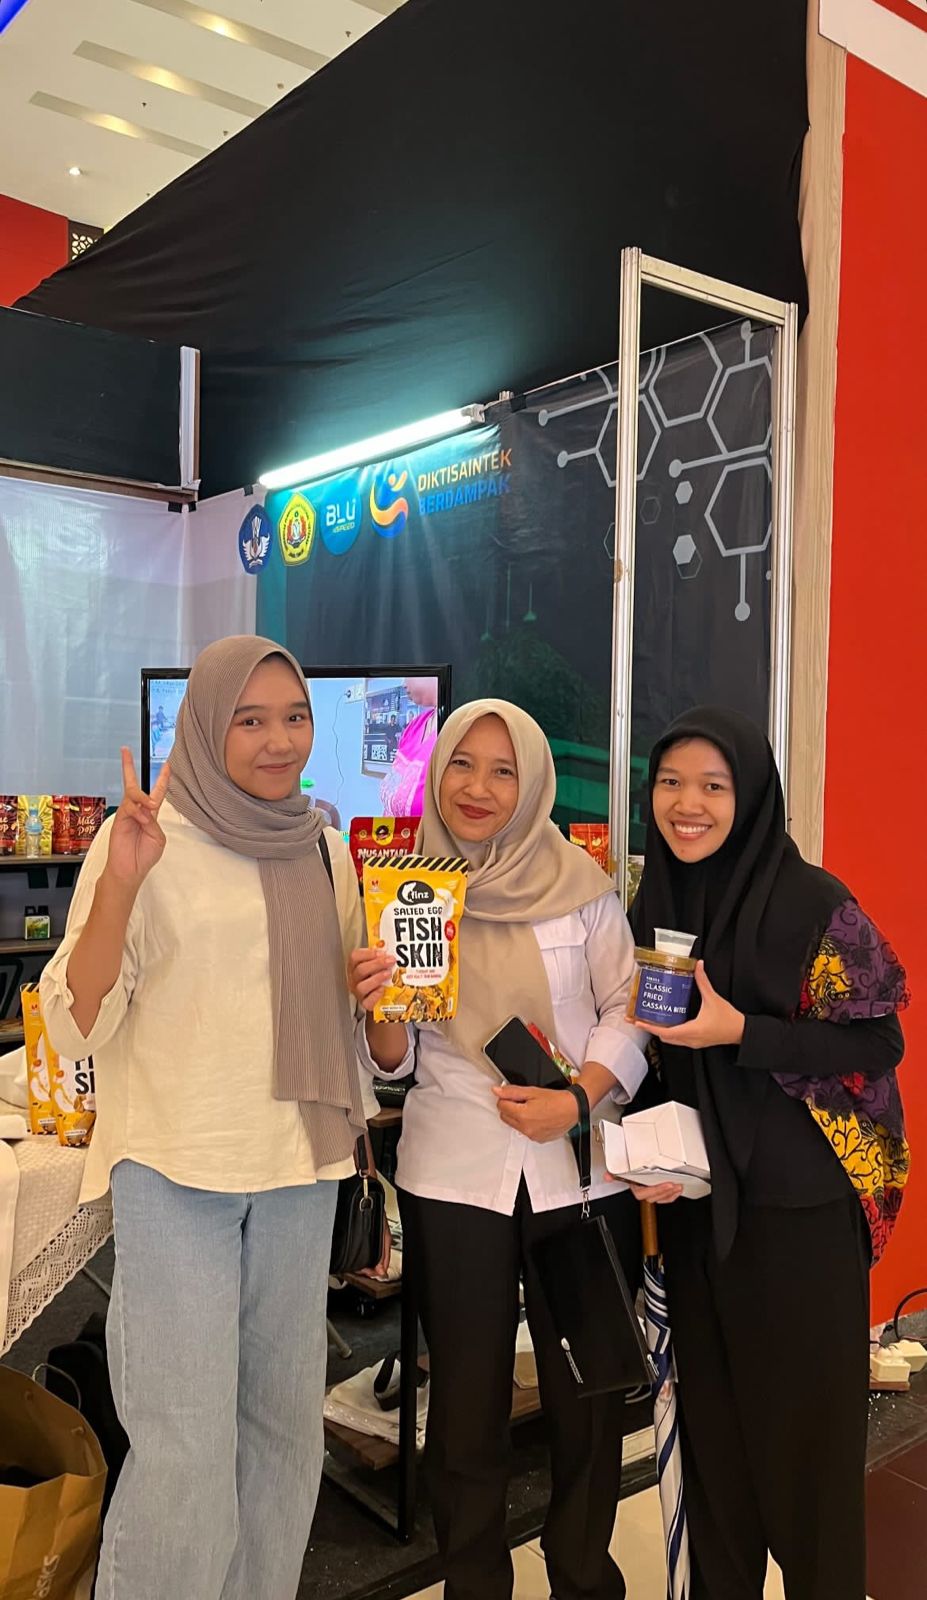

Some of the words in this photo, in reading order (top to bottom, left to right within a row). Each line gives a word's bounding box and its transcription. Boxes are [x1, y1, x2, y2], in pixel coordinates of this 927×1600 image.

[418, 448, 512, 492] DIKTISAINTEK
[419, 473, 512, 516] BERDAMPAK
[326, 499, 356, 527] BLU
[393, 907, 425, 916] SALTED
[427, 906, 443, 915] EGG
[394, 916, 442, 942] FISH
[395, 942, 443, 968] SKIN
[643, 991, 663, 1002] FRIED
[644, 982, 673, 994] CLASSIC
[641, 1000, 673, 1013] CASSAVA
